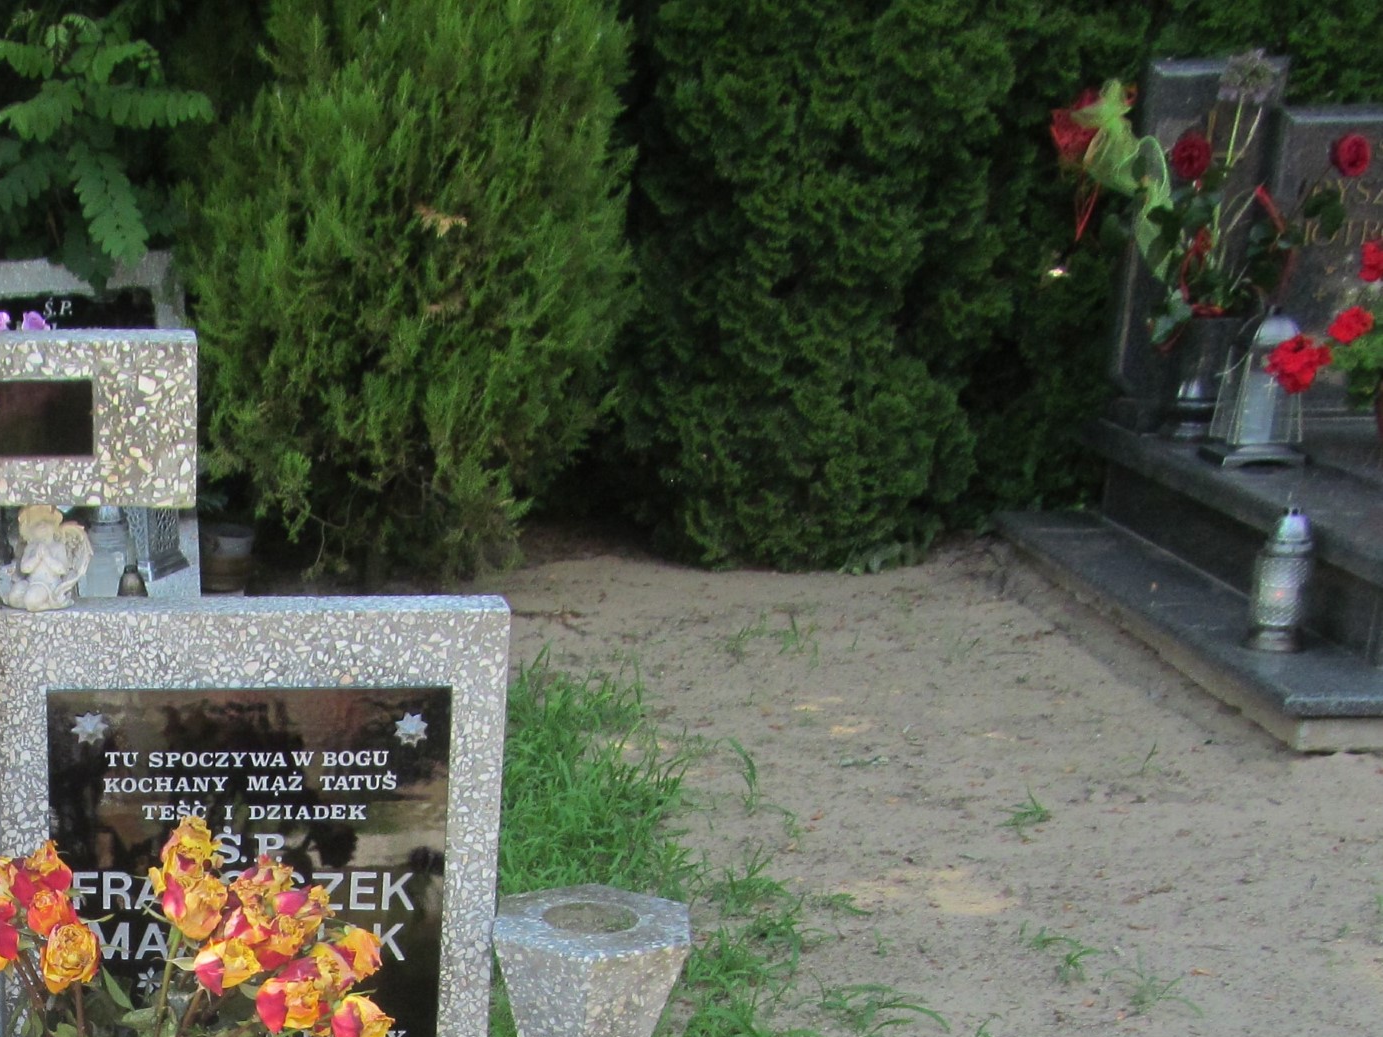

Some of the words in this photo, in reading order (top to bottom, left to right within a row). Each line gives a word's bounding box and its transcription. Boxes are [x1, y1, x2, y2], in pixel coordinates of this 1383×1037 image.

[104, 752, 138, 767] TU
[148, 751, 287, 768] SPOCZYWA
[291, 750, 315, 767] W
[322, 751, 390, 767] BOGU
[103, 776, 229, 793] KOCHANY
[246, 771, 303, 796] MĄŻ
[319, 770, 397, 791] TATUŚ
[142, 800, 207, 820] TEŚĆ
[223, 805, 233, 820] I
[249, 804, 367, 820] DZIADEK
